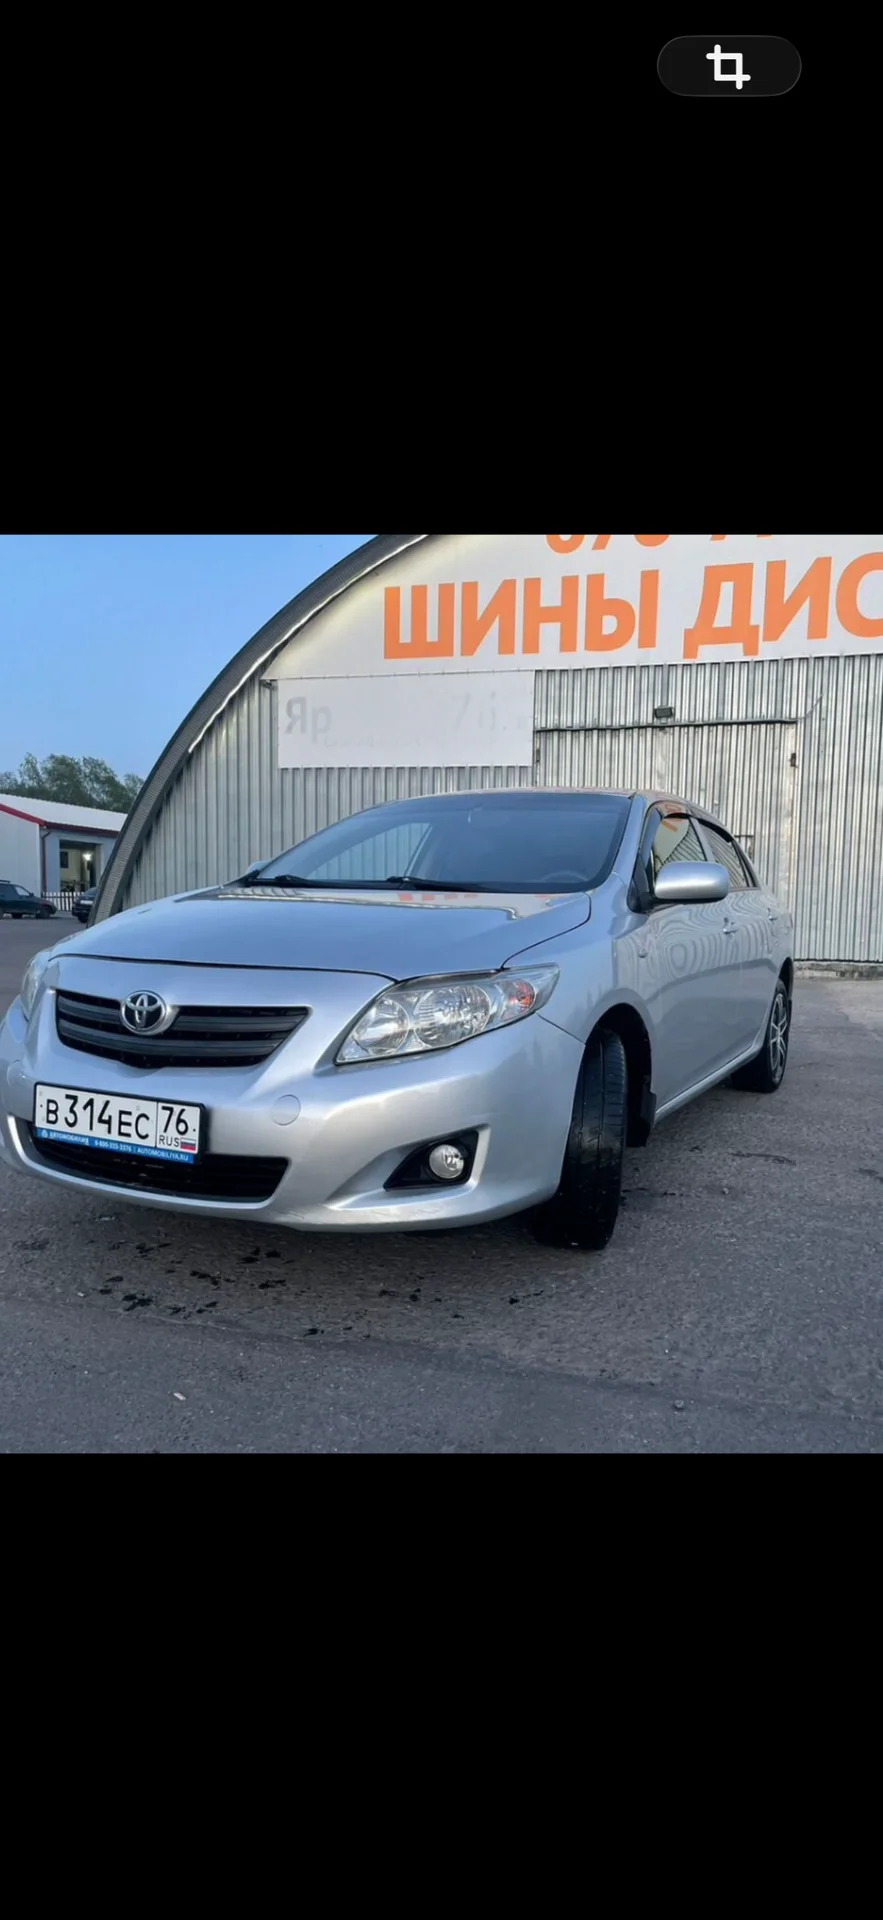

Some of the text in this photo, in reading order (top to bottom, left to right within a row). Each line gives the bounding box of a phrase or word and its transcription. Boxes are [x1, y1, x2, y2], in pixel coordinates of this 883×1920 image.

[383, 569, 660, 659] ШИНЫ
[46, 1094, 150, 1139] В314ЕС
[161, 1106, 188, 1135] 76
[159, 1135, 180, 1148] RUS
